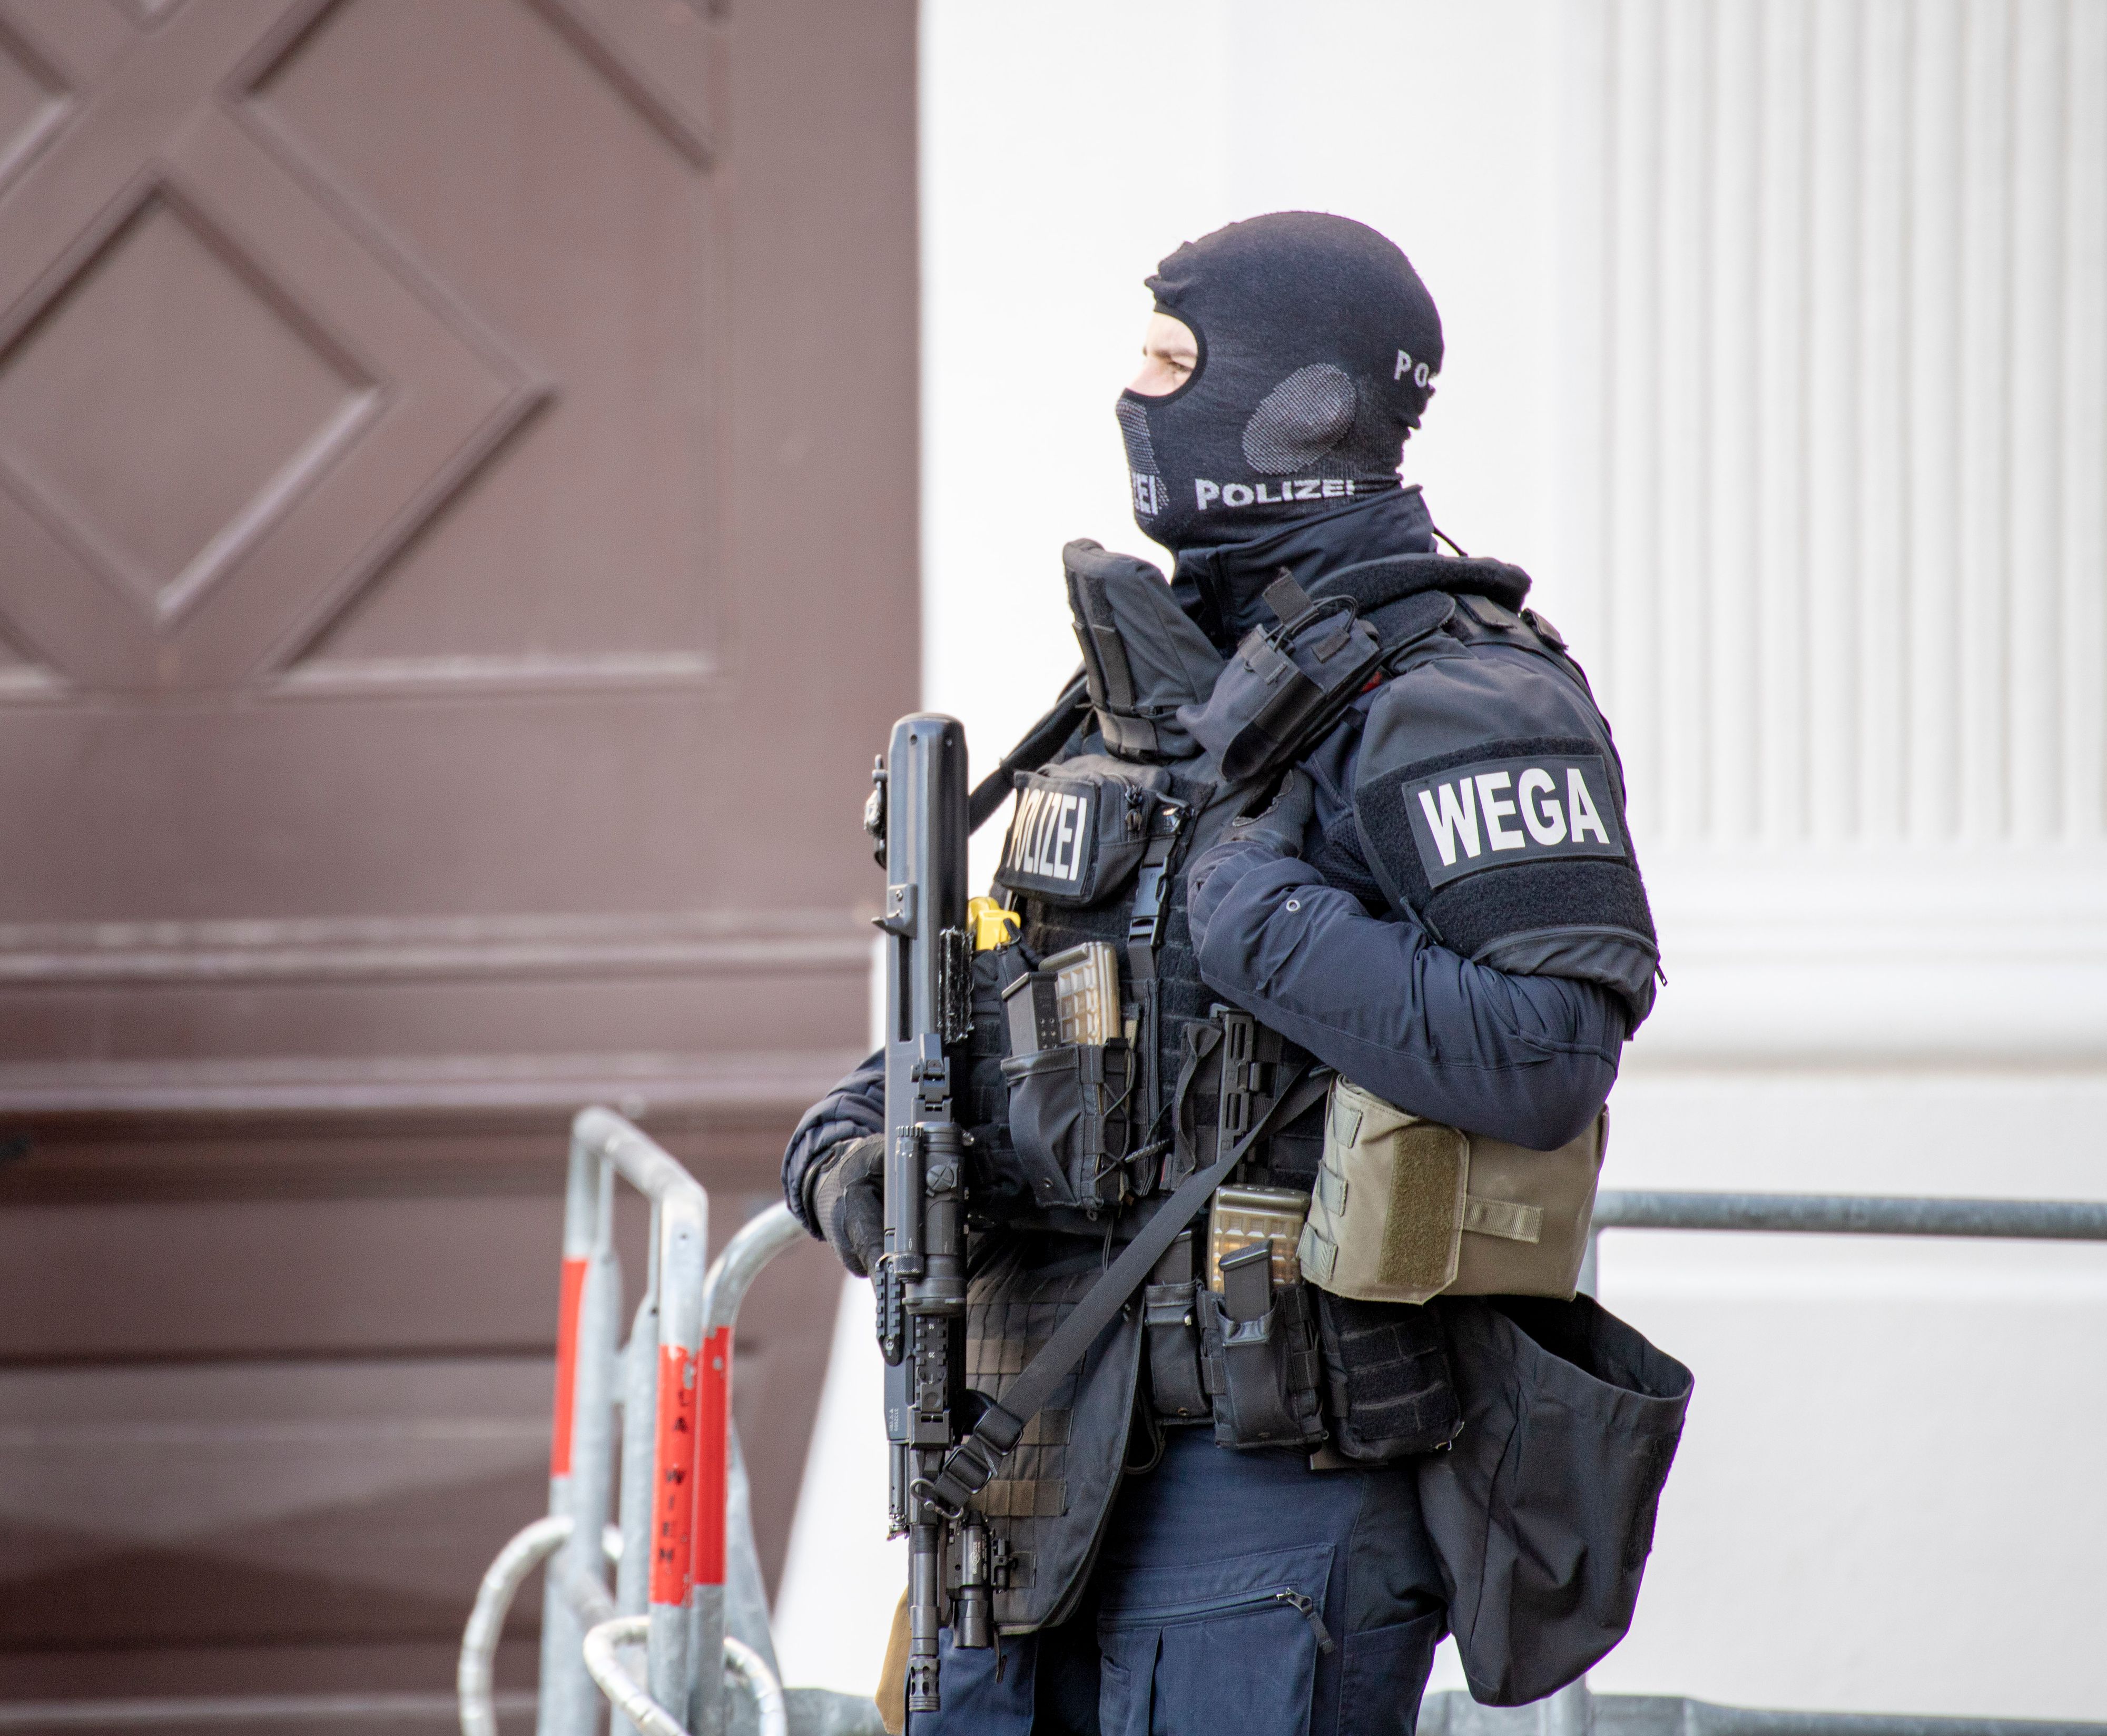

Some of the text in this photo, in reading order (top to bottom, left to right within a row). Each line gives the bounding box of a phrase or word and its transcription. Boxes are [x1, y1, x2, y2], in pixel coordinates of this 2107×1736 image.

[1394, 349, 1429, 387] PO
[1195, 478, 1355, 511] POLIZEI
[1006, 787, 1087, 881] POLIZEI
[1419, 768, 1610, 866] WEGA
